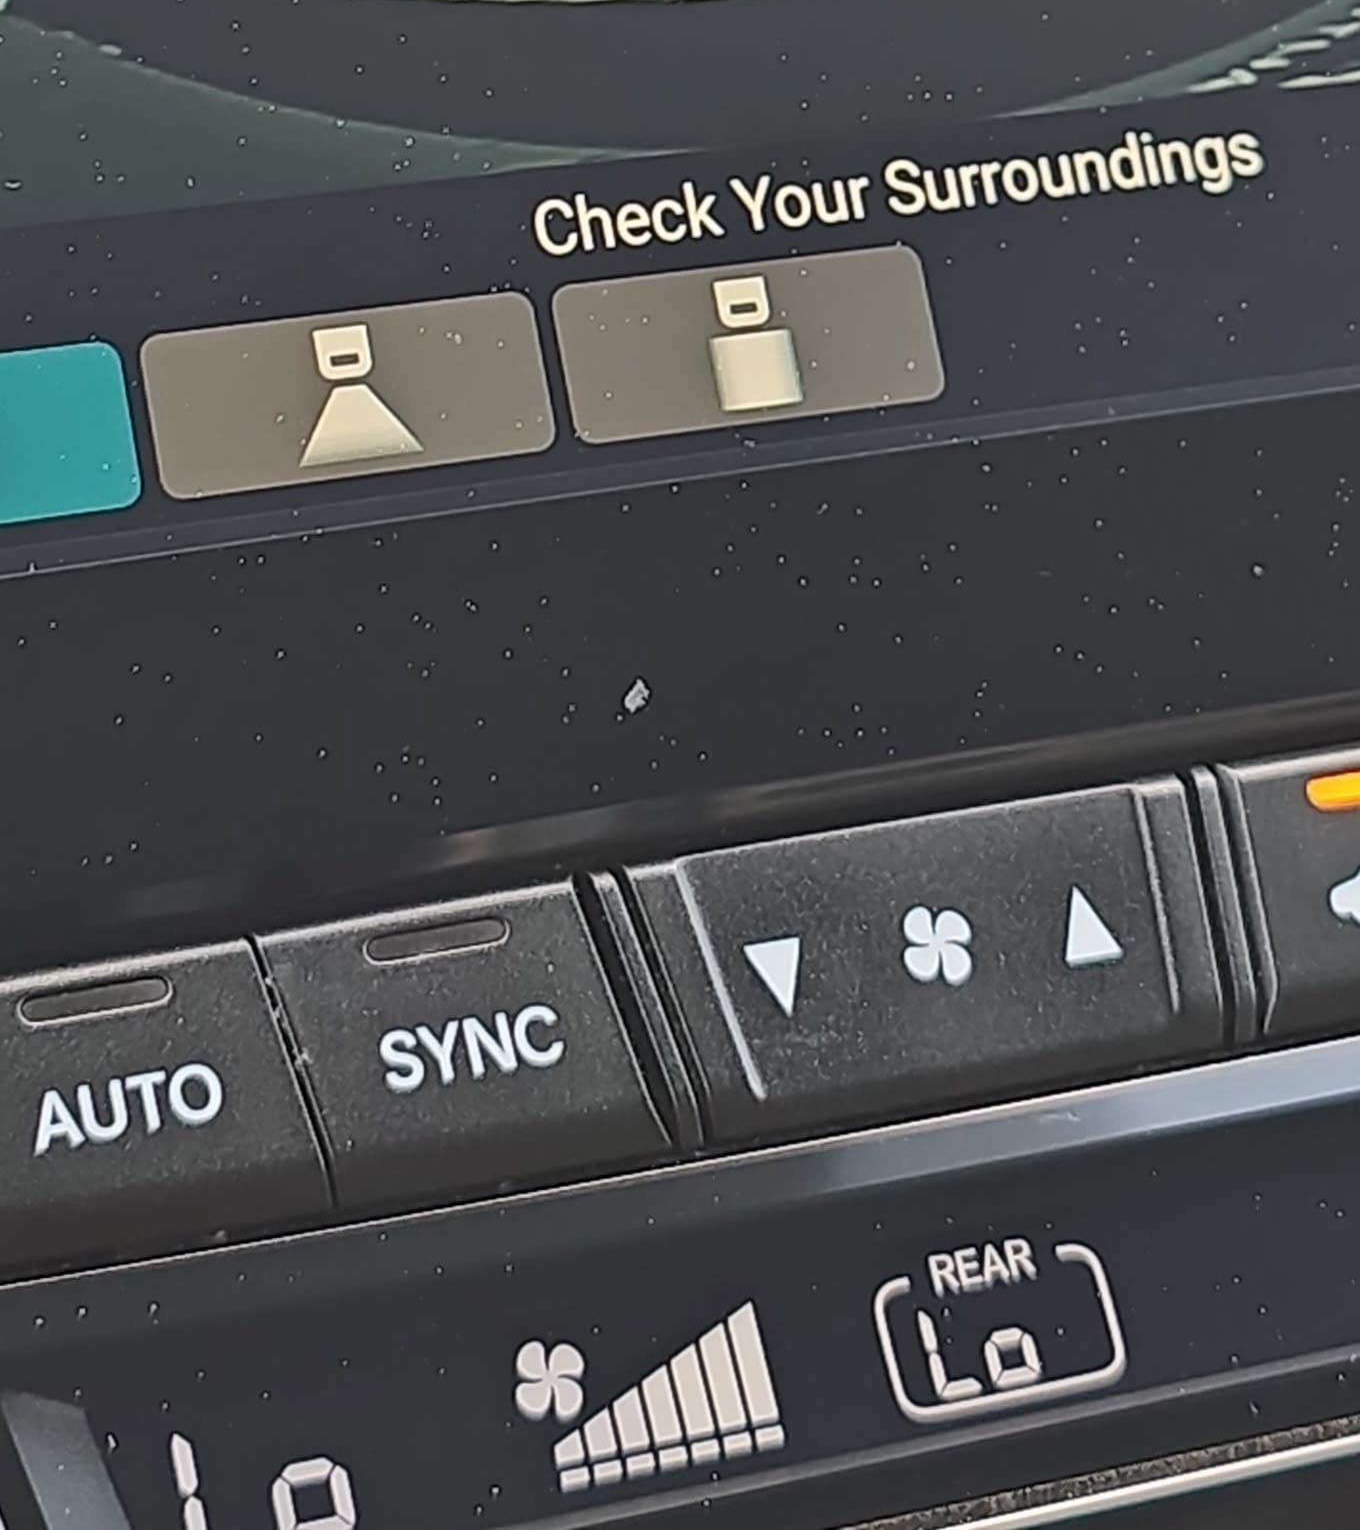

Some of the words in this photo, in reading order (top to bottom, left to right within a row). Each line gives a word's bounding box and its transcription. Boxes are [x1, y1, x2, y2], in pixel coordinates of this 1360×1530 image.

[533, 181, 725, 257] Check
[729, 173, 870, 233] Your
[882, 132, 1264, 216] Surroundings
[378, 1005, 566, 1094] SYNC
[33, 1062, 224, 1158] AUTO
[927, 1237, 1037, 1299] REAR
[917, 1309, 1042, 1402] Lo
